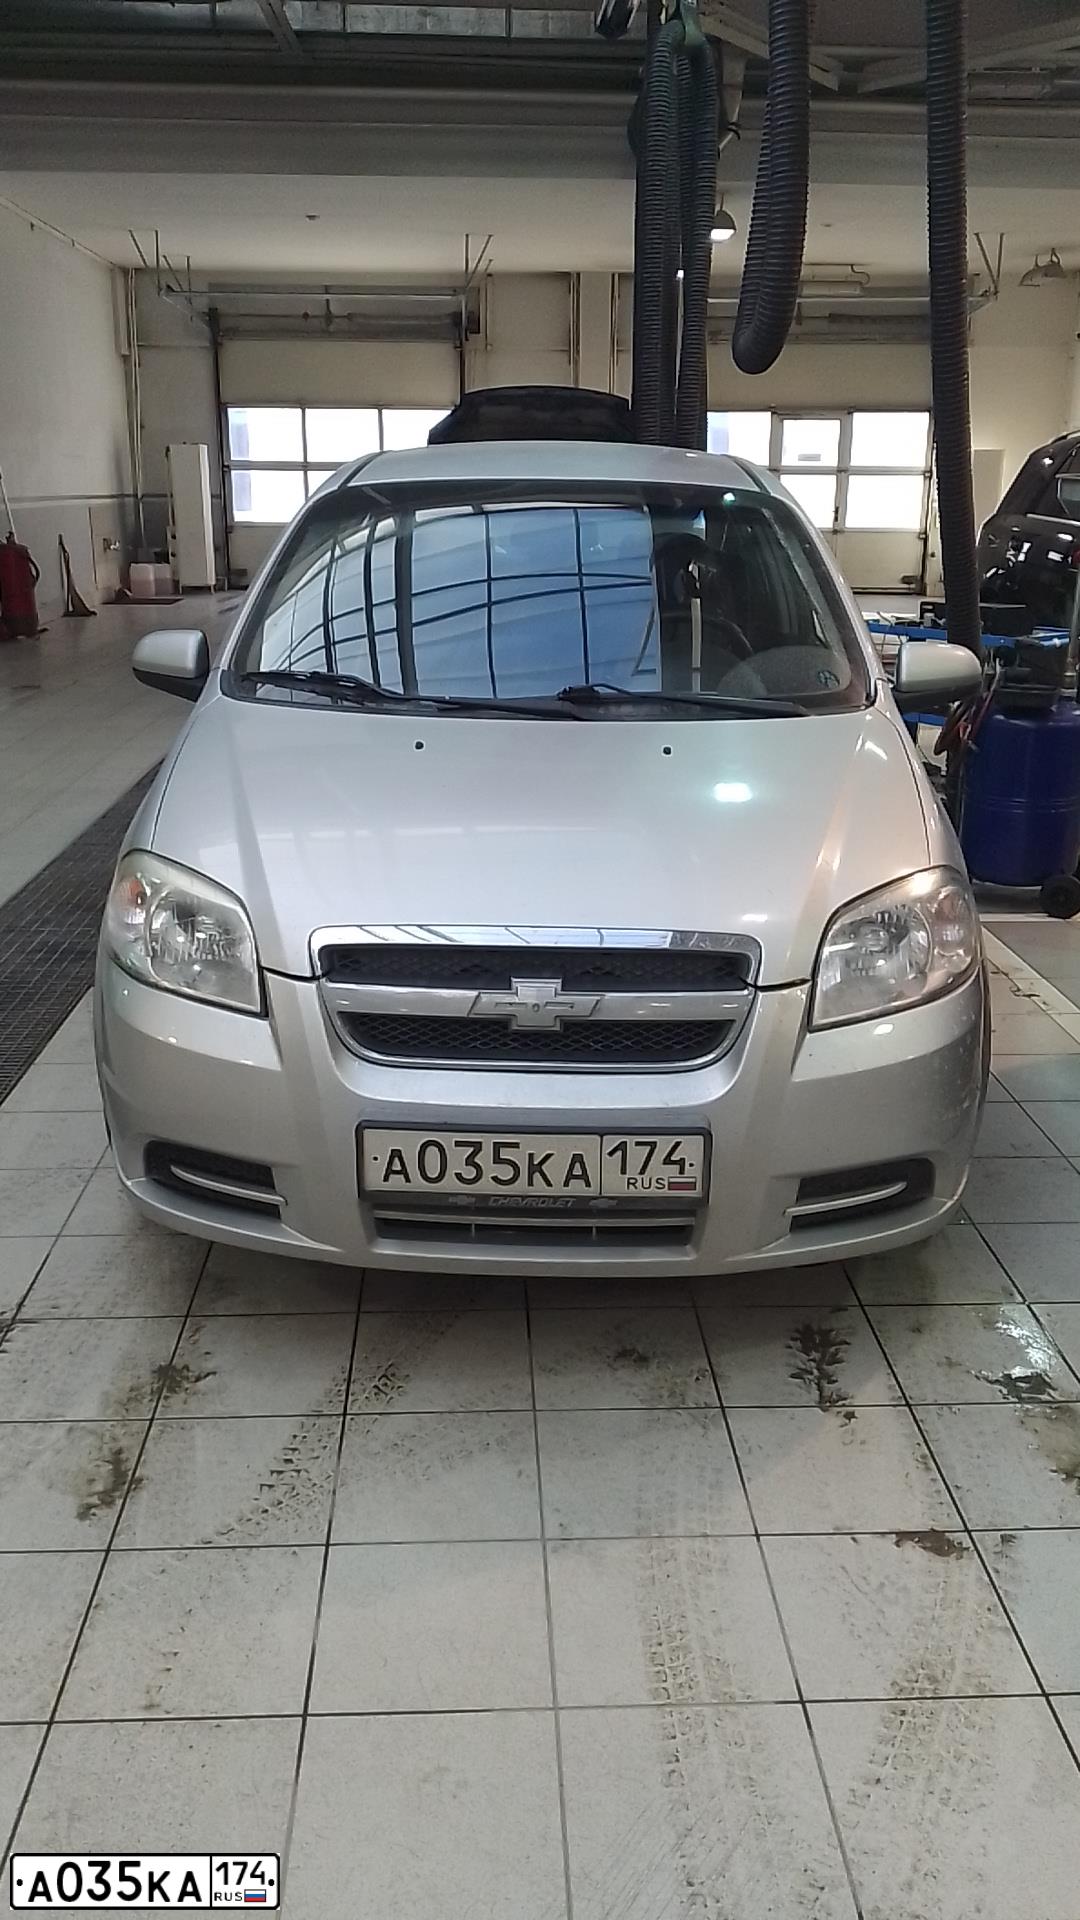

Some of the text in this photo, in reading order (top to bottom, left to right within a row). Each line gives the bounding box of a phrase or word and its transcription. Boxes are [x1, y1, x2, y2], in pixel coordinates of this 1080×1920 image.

[606, 1140, 687, 1176] 174
[627, 1177, 666, 1191] RUS
[488, 1196, 577, 1209] CHEVROLET
